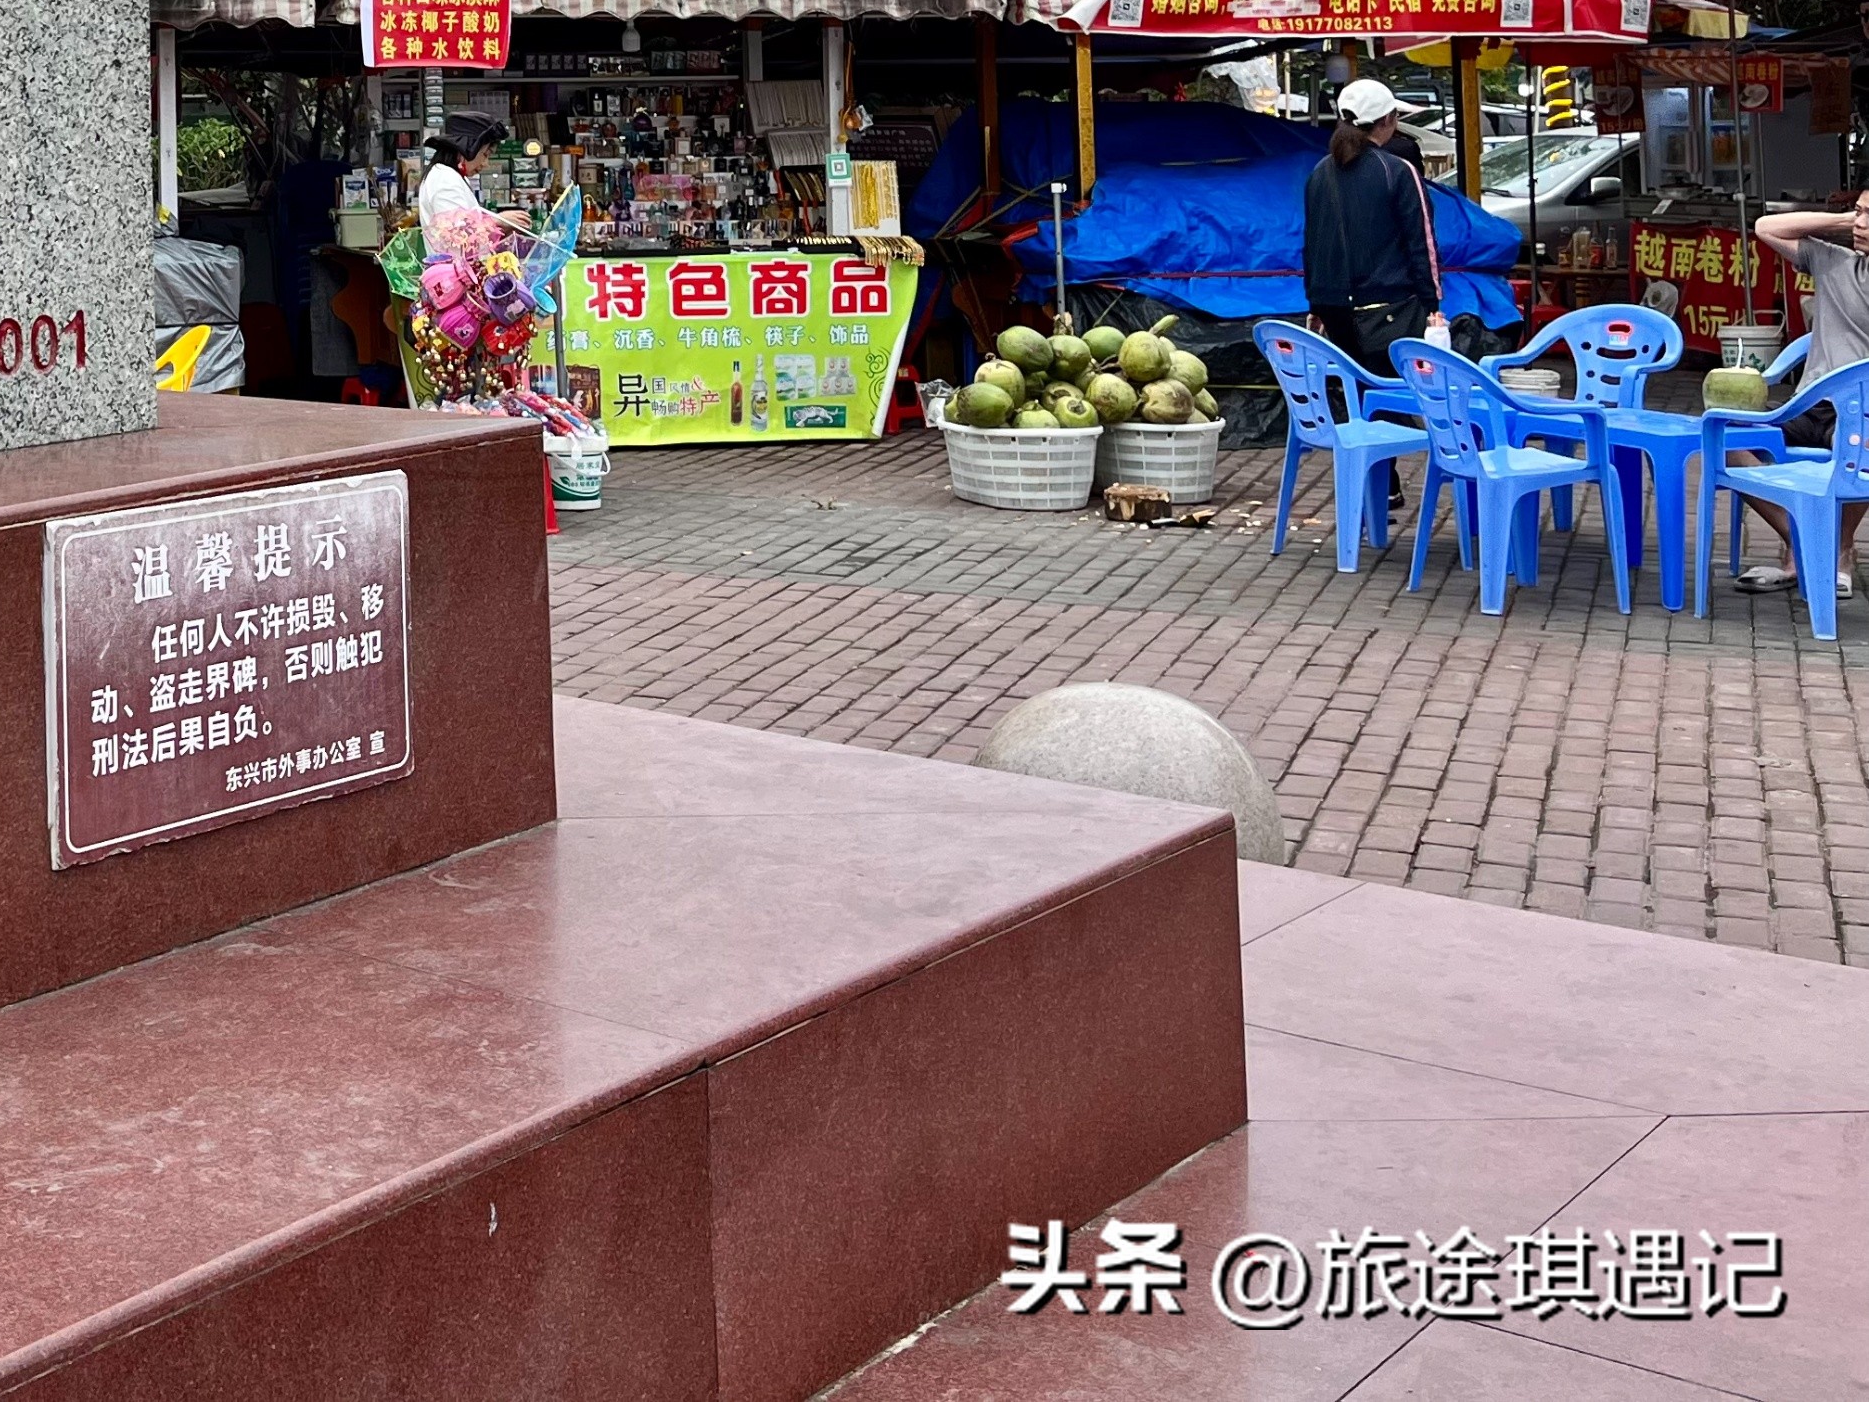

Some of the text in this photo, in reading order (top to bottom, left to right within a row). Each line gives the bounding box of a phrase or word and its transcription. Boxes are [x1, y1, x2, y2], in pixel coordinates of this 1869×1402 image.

[380, 9, 500, 34] 冰冻椰子酸奶
[380, 36, 501, 60] 各种水饮料
[561, 257, 891, 320] 特色商品
[1634, 229, 1760, 288] 越南卷粉
[131, 514, 349, 604] 温馨提示
[151, 583, 385, 664] 任何人不许损毁、移
[91, 631, 383, 726] 动、盗走界碑，否则触犯
[92, 705, 273, 777] 刑法后果自负。
[225, 730, 386, 793] 东兴市外事办公室 宣
